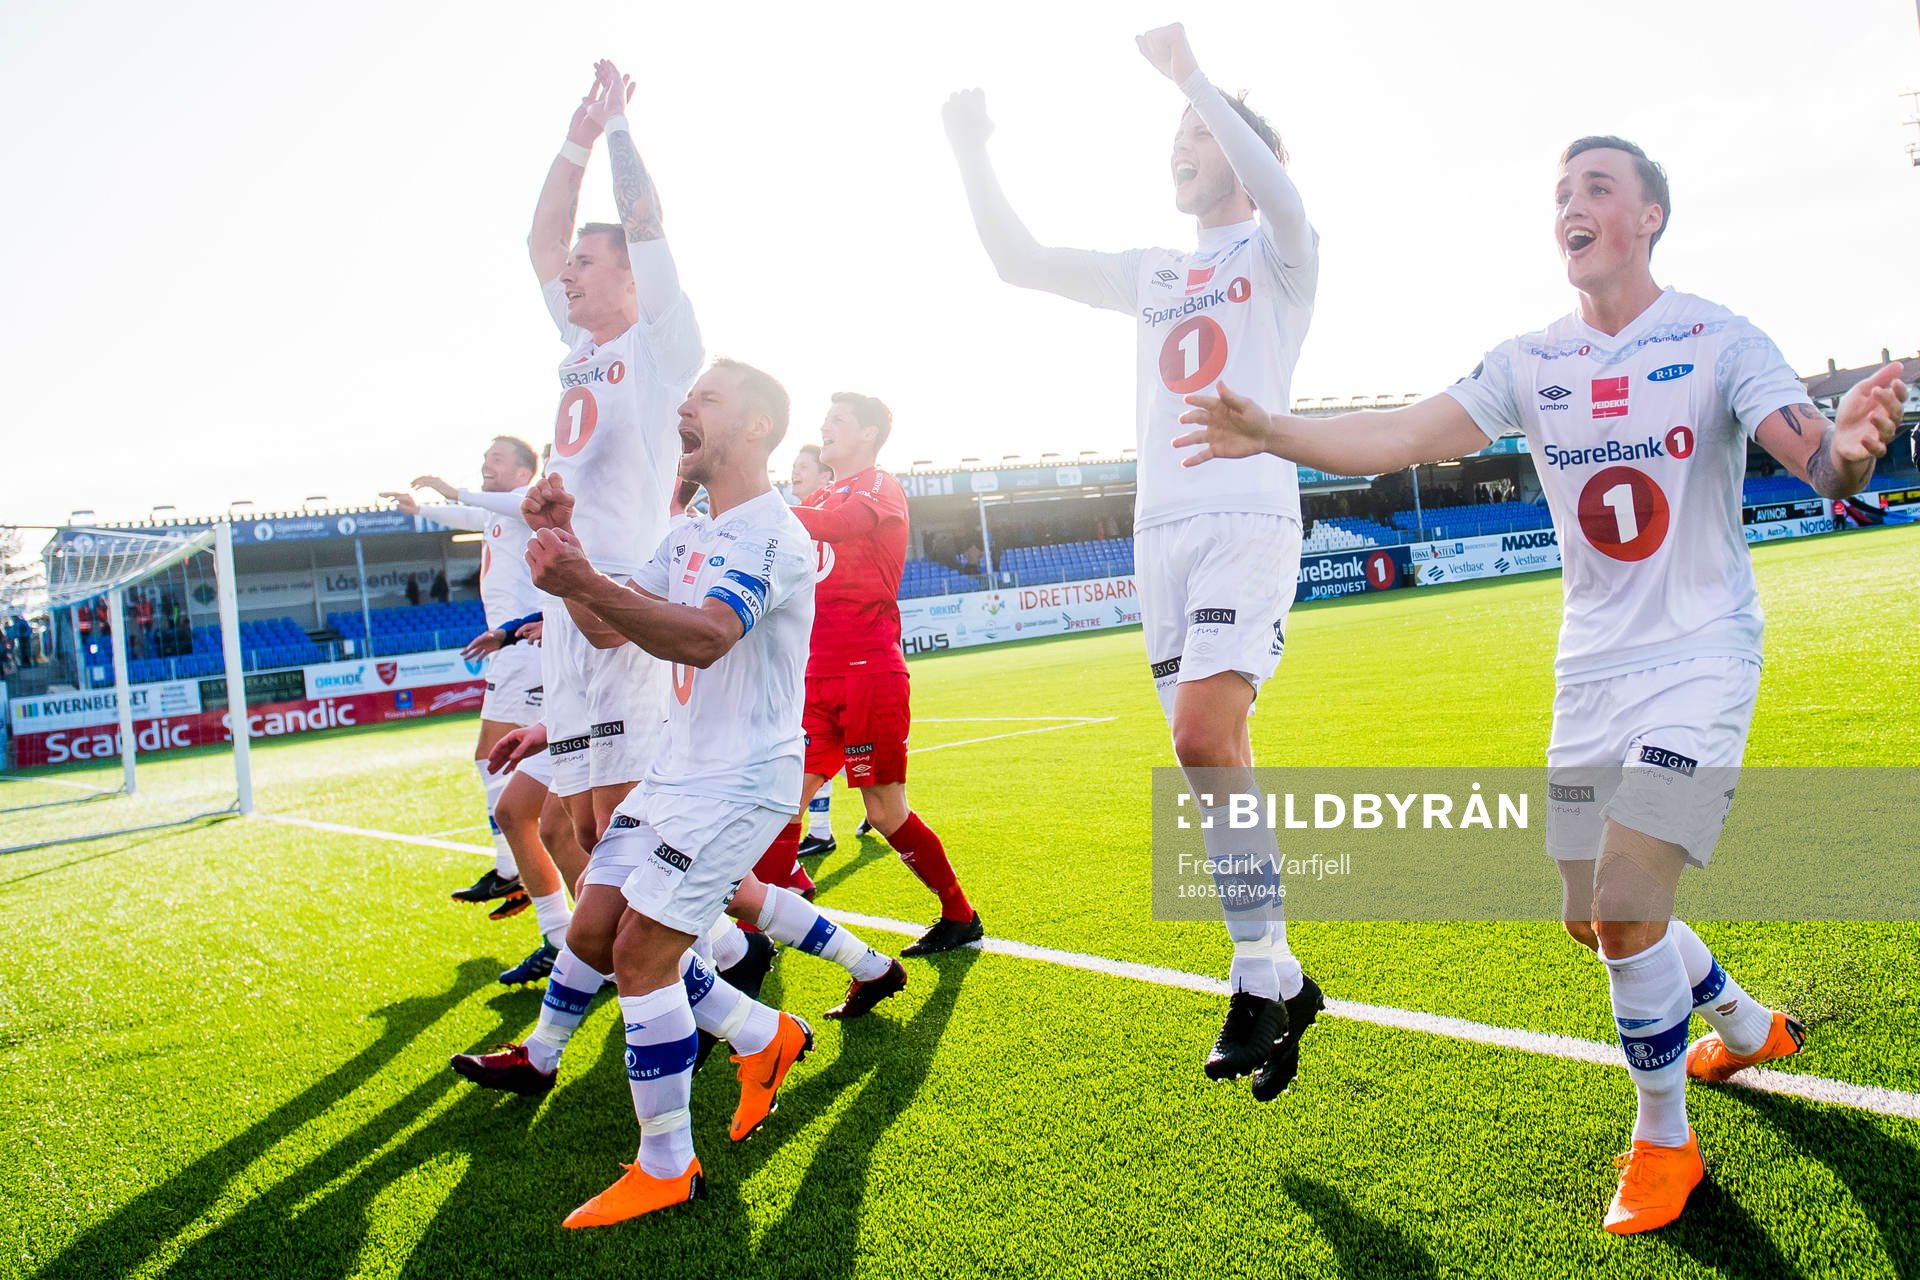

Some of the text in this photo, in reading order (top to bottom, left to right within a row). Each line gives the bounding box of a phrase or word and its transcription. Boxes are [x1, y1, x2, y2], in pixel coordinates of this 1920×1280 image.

[1151, 279, 1173, 290] umbro
[1142, 288, 1226, 328] SpareBank
[1178, 327, 1200, 379] 1
[1540, 402, 1569, 411] umbro
[568, 399, 584, 445] 1
[1544, 436, 1665, 470] SpareBank
[1602, 483, 1639, 544] 1
[1756, 507, 1788, 521] AVINOR
[1448, 561, 1485, 574] Vestbase
[1513, 553, 1547, 565] Vestbase
[326, 567, 435, 592] Låsenteet
[1312, 580, 1367, 596] NORDVEST
[1019, 580, 1138, 611] IDRETTSBARN
[929, 603, 962, 617] ORKIDE
[1071, 617, 1101, 629] PRETRE
[902, 633, 950, 654] HUS
[315, 672, 363, 689] ORKIDE
[43, 690, 148, 716] KVERNBEET
[1639, 748, 1694, 774] DESIGN
